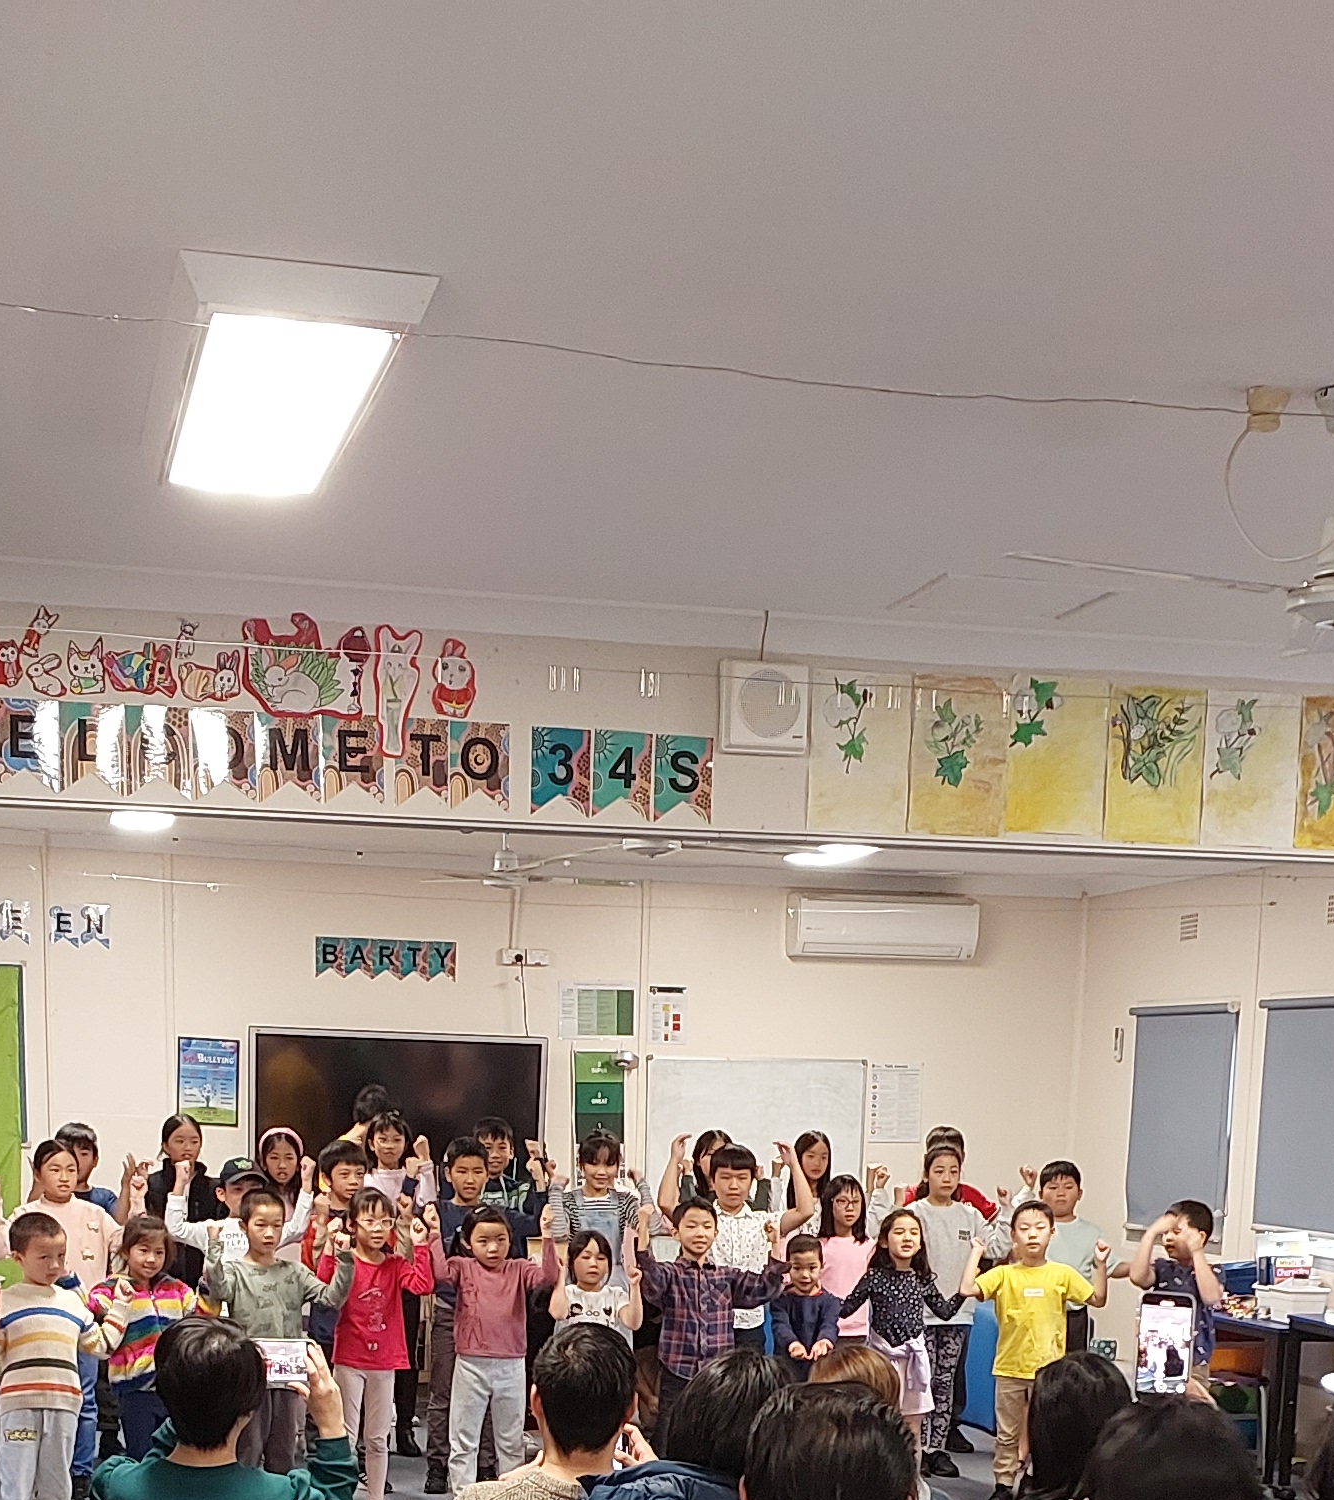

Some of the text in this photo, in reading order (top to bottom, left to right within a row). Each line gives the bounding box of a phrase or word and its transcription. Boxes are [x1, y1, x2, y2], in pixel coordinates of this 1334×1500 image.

[409, 733, 500, 782] TO
[547, 742, 700, 794] 34S
[322, 944, 451, 968] BARTY
